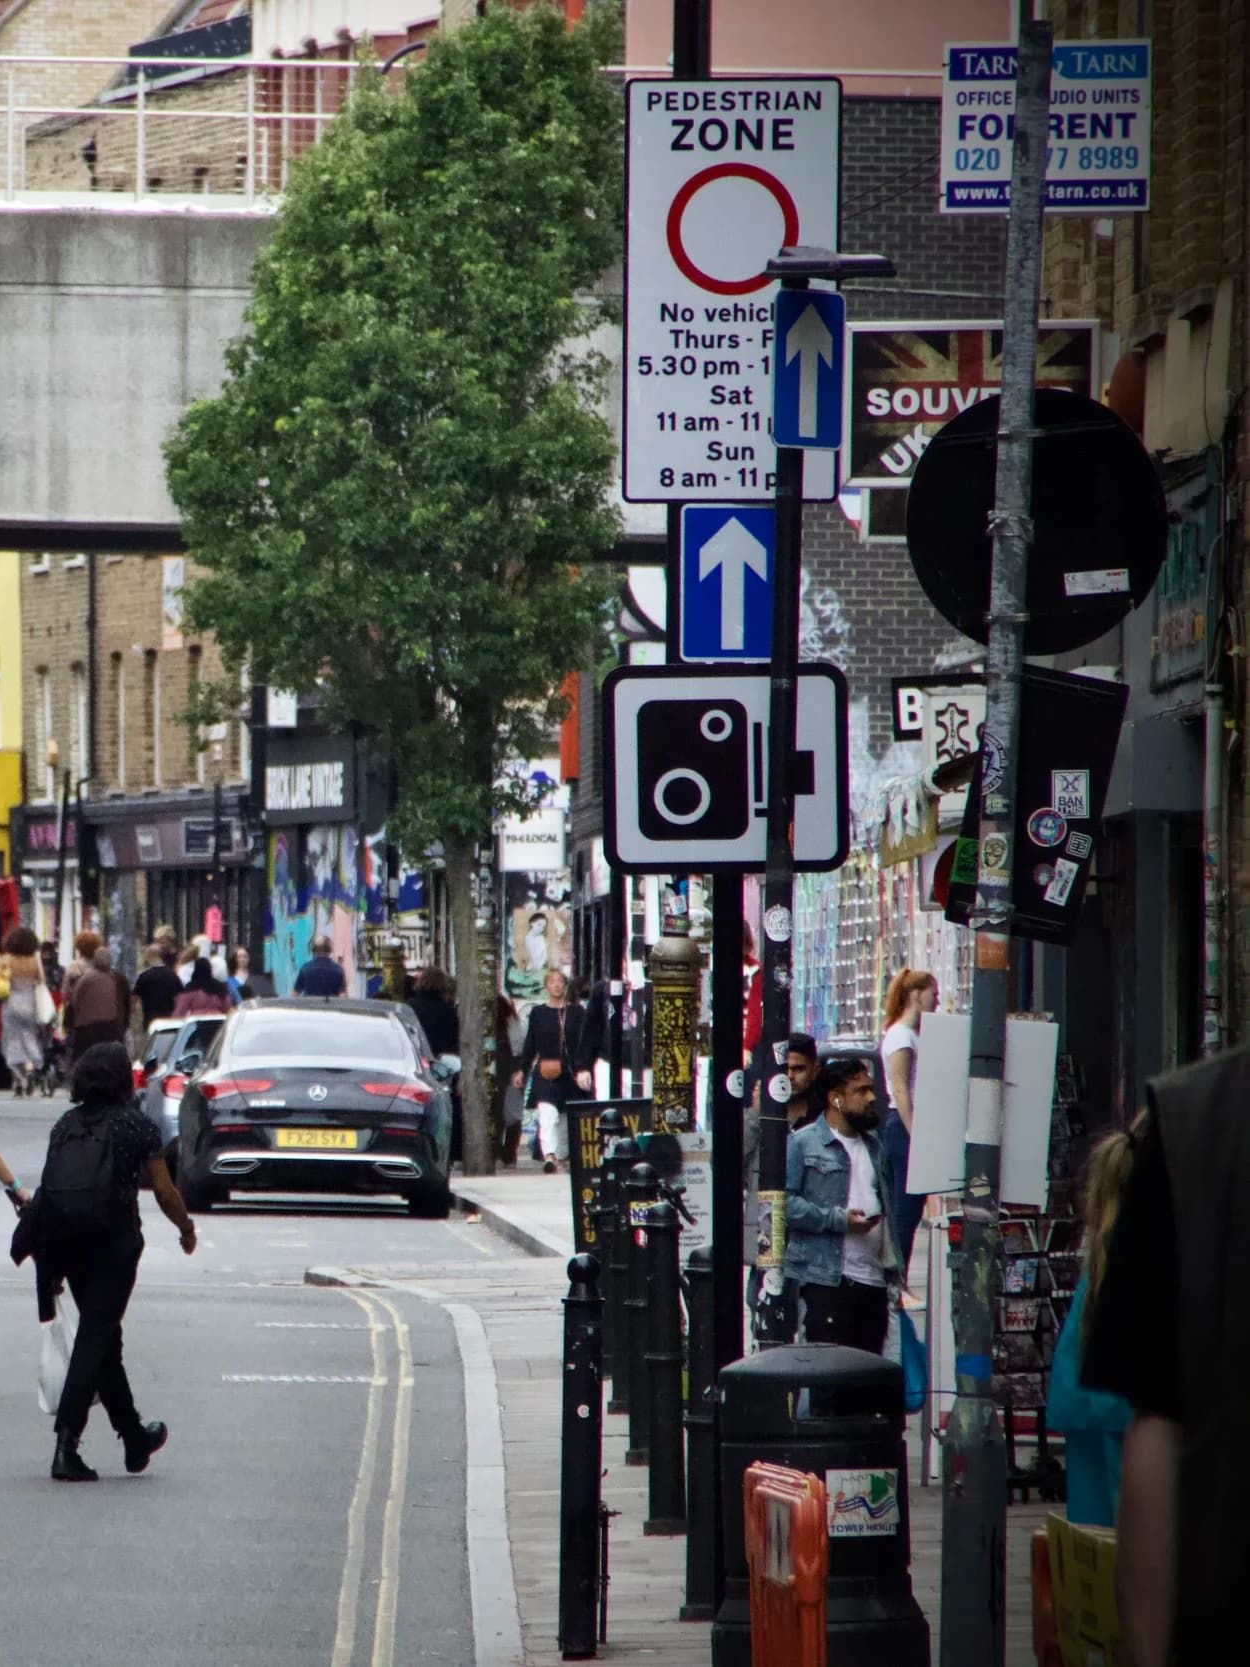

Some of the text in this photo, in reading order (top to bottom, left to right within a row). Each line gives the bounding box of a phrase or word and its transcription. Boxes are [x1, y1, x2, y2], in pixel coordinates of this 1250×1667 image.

[1070, 51, 1137, 73] TARN
[647, 91, 822, 111] PEDESTRIAN
[1092, 89, 1140, 103] UNITS
[671, 118, 795, 151] ZONE
[1048, 112, 1137, 139] RENT
[955, 148, 1000, 170] 020
[1078, 146, 1139, 170] 8989
[660, 303, 694, 322] No
[669, 329, 740, 349] Thurs
[638, 355, 697, 376] 5.30
[703, 360, 740, 379] pm
[710, 385, 753, 405] Sat
[657, 412, 677, 431] 11
[684, 416, 719, 431] am
[741, 412, 760, 431] 11
[707, 441, 755, 461] Sun
[660, 468, 675, 487] 8
[681, 472, 717, 487] am
[738, 468, 758, 487] 11
[1058, 796, 1083, 806] BAN
[831, 1523, 863, 1533] TOWER
